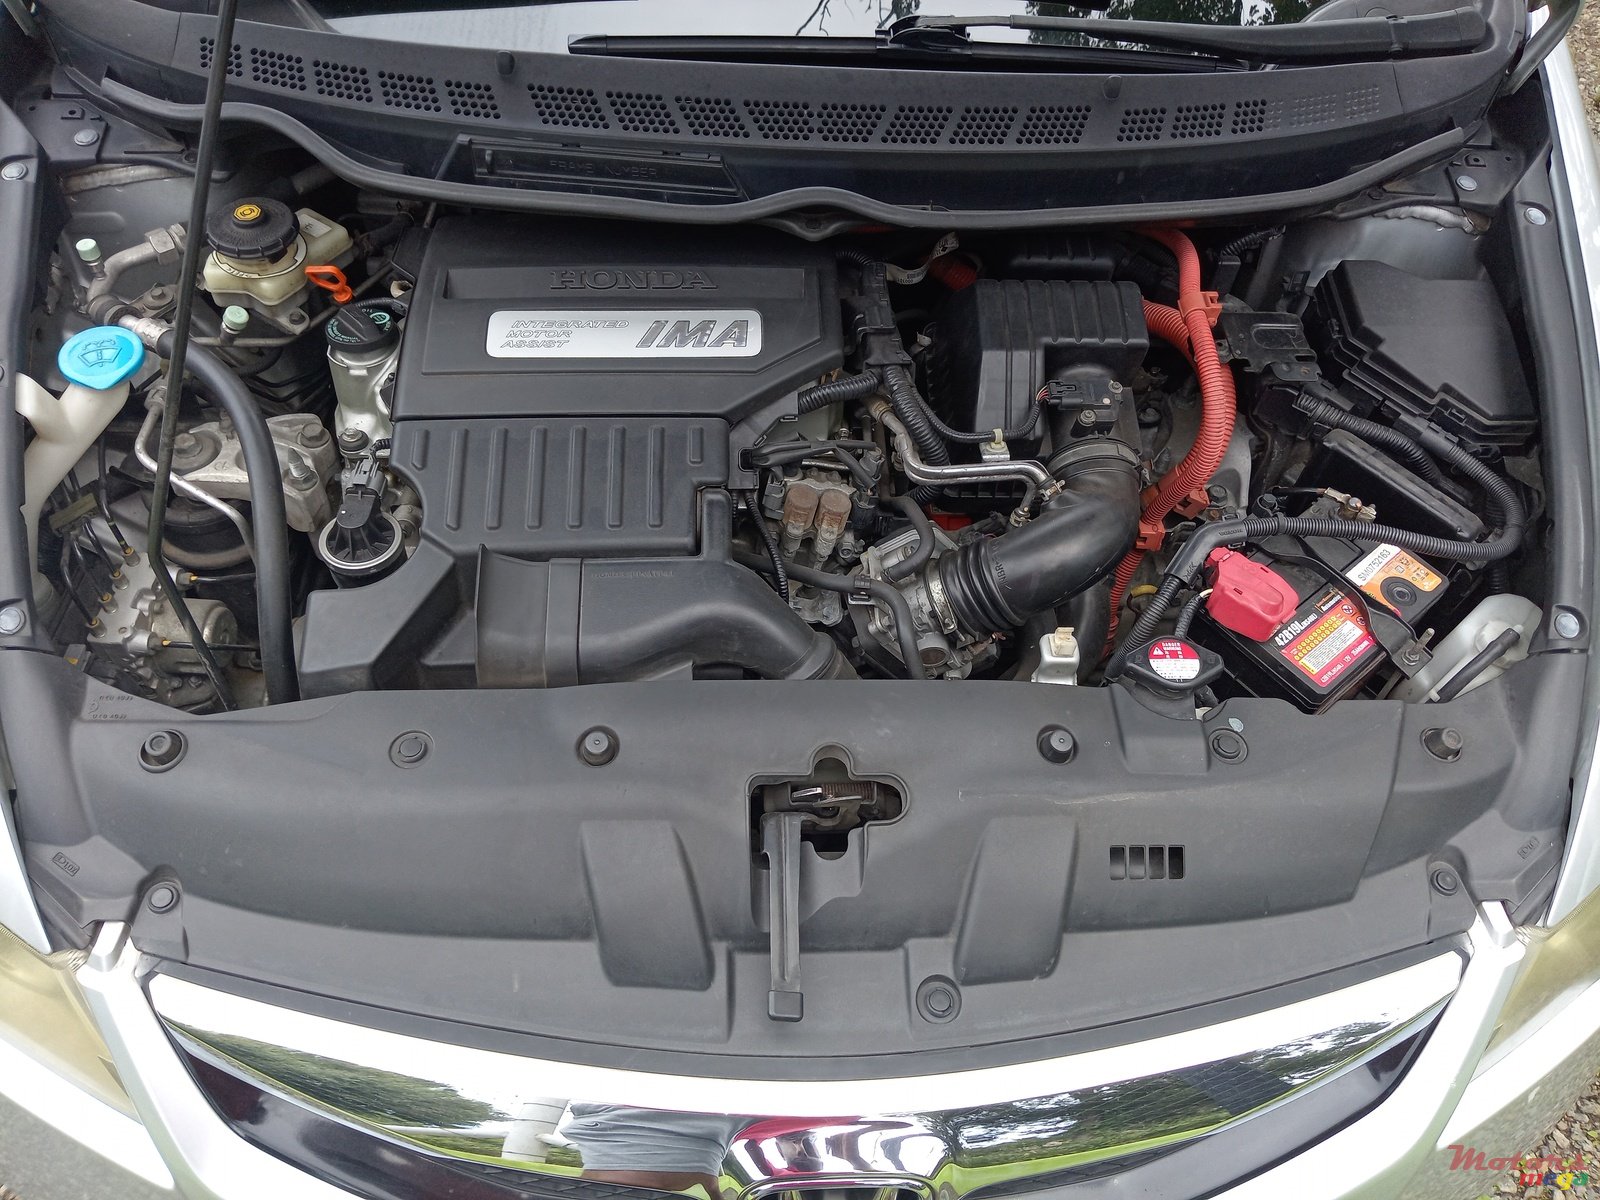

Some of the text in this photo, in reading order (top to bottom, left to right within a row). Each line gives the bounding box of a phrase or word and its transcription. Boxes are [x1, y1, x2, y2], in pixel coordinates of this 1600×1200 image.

[549, 270, 718, 290] HONDA
[510, 320, 630, 329] INTEGRATED
[505, 330, 572, 339] MOTOR
[635, 319, 750, 349] IMA
[500, 340, 570, 349] ASSIST
[1357, 549, 1391, 582] SM0752163
